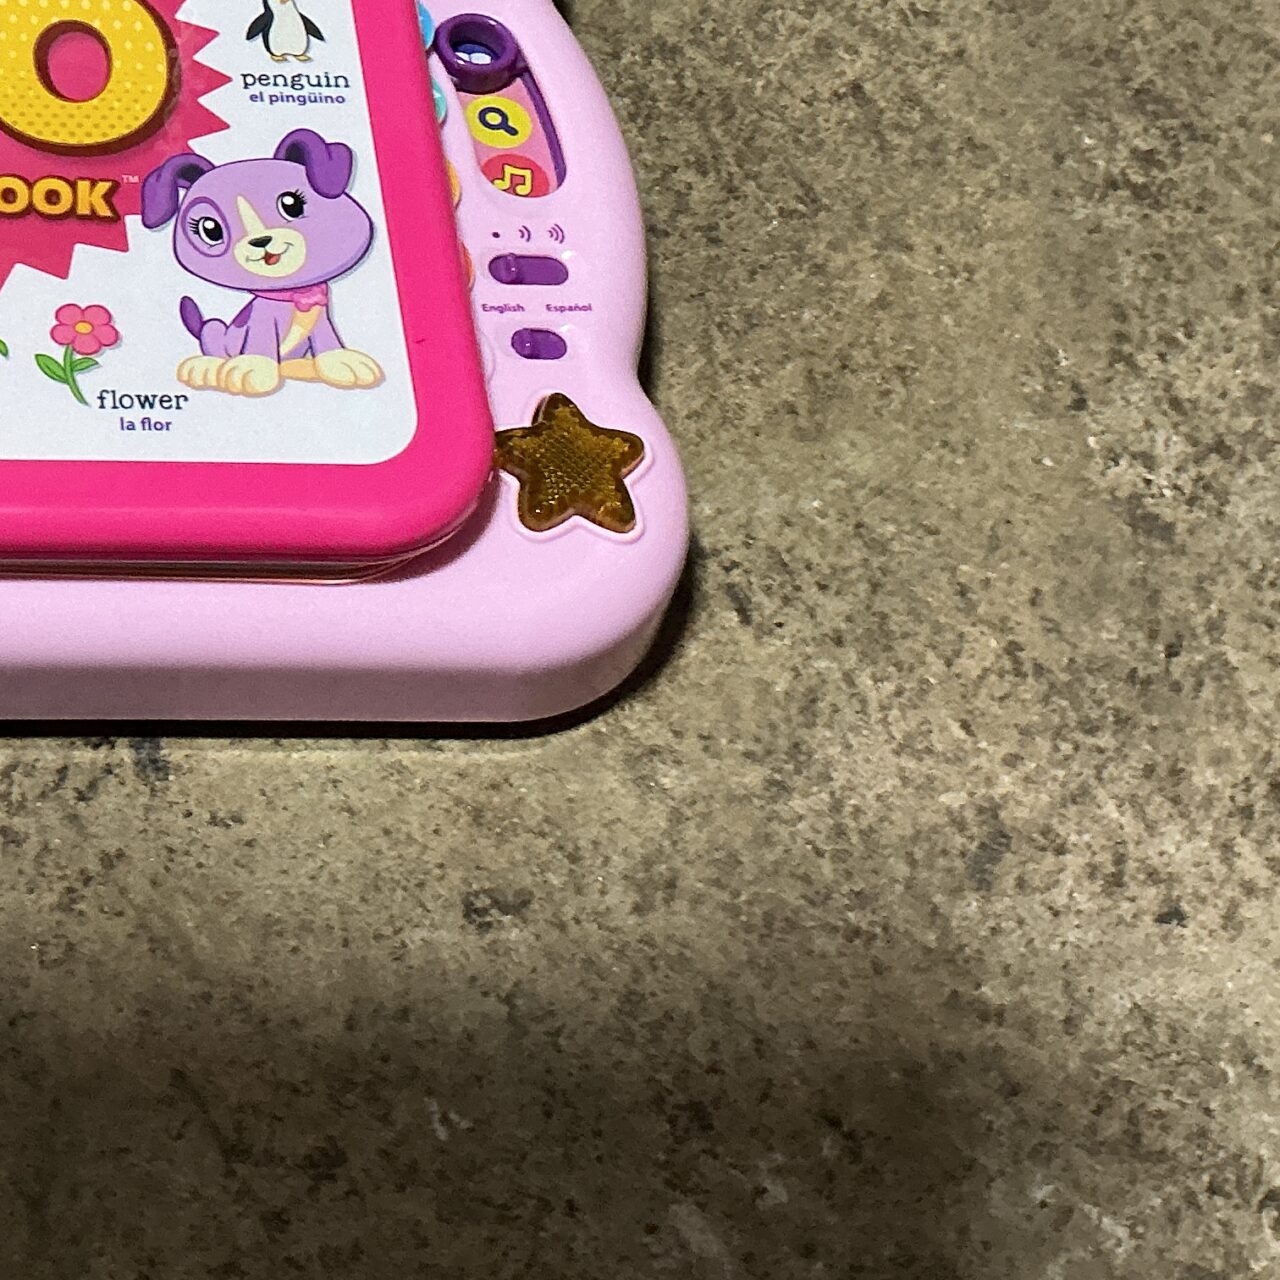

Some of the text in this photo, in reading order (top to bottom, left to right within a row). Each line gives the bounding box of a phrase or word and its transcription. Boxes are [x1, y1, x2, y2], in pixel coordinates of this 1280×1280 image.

[241, 72, 351, 90] penguin
[249, 91, 346, 105] el pingüino
[481, 302, 593, 314] English Español
[96, 388, 189, 411] flower
[119, 417, 172, 432] la flor
